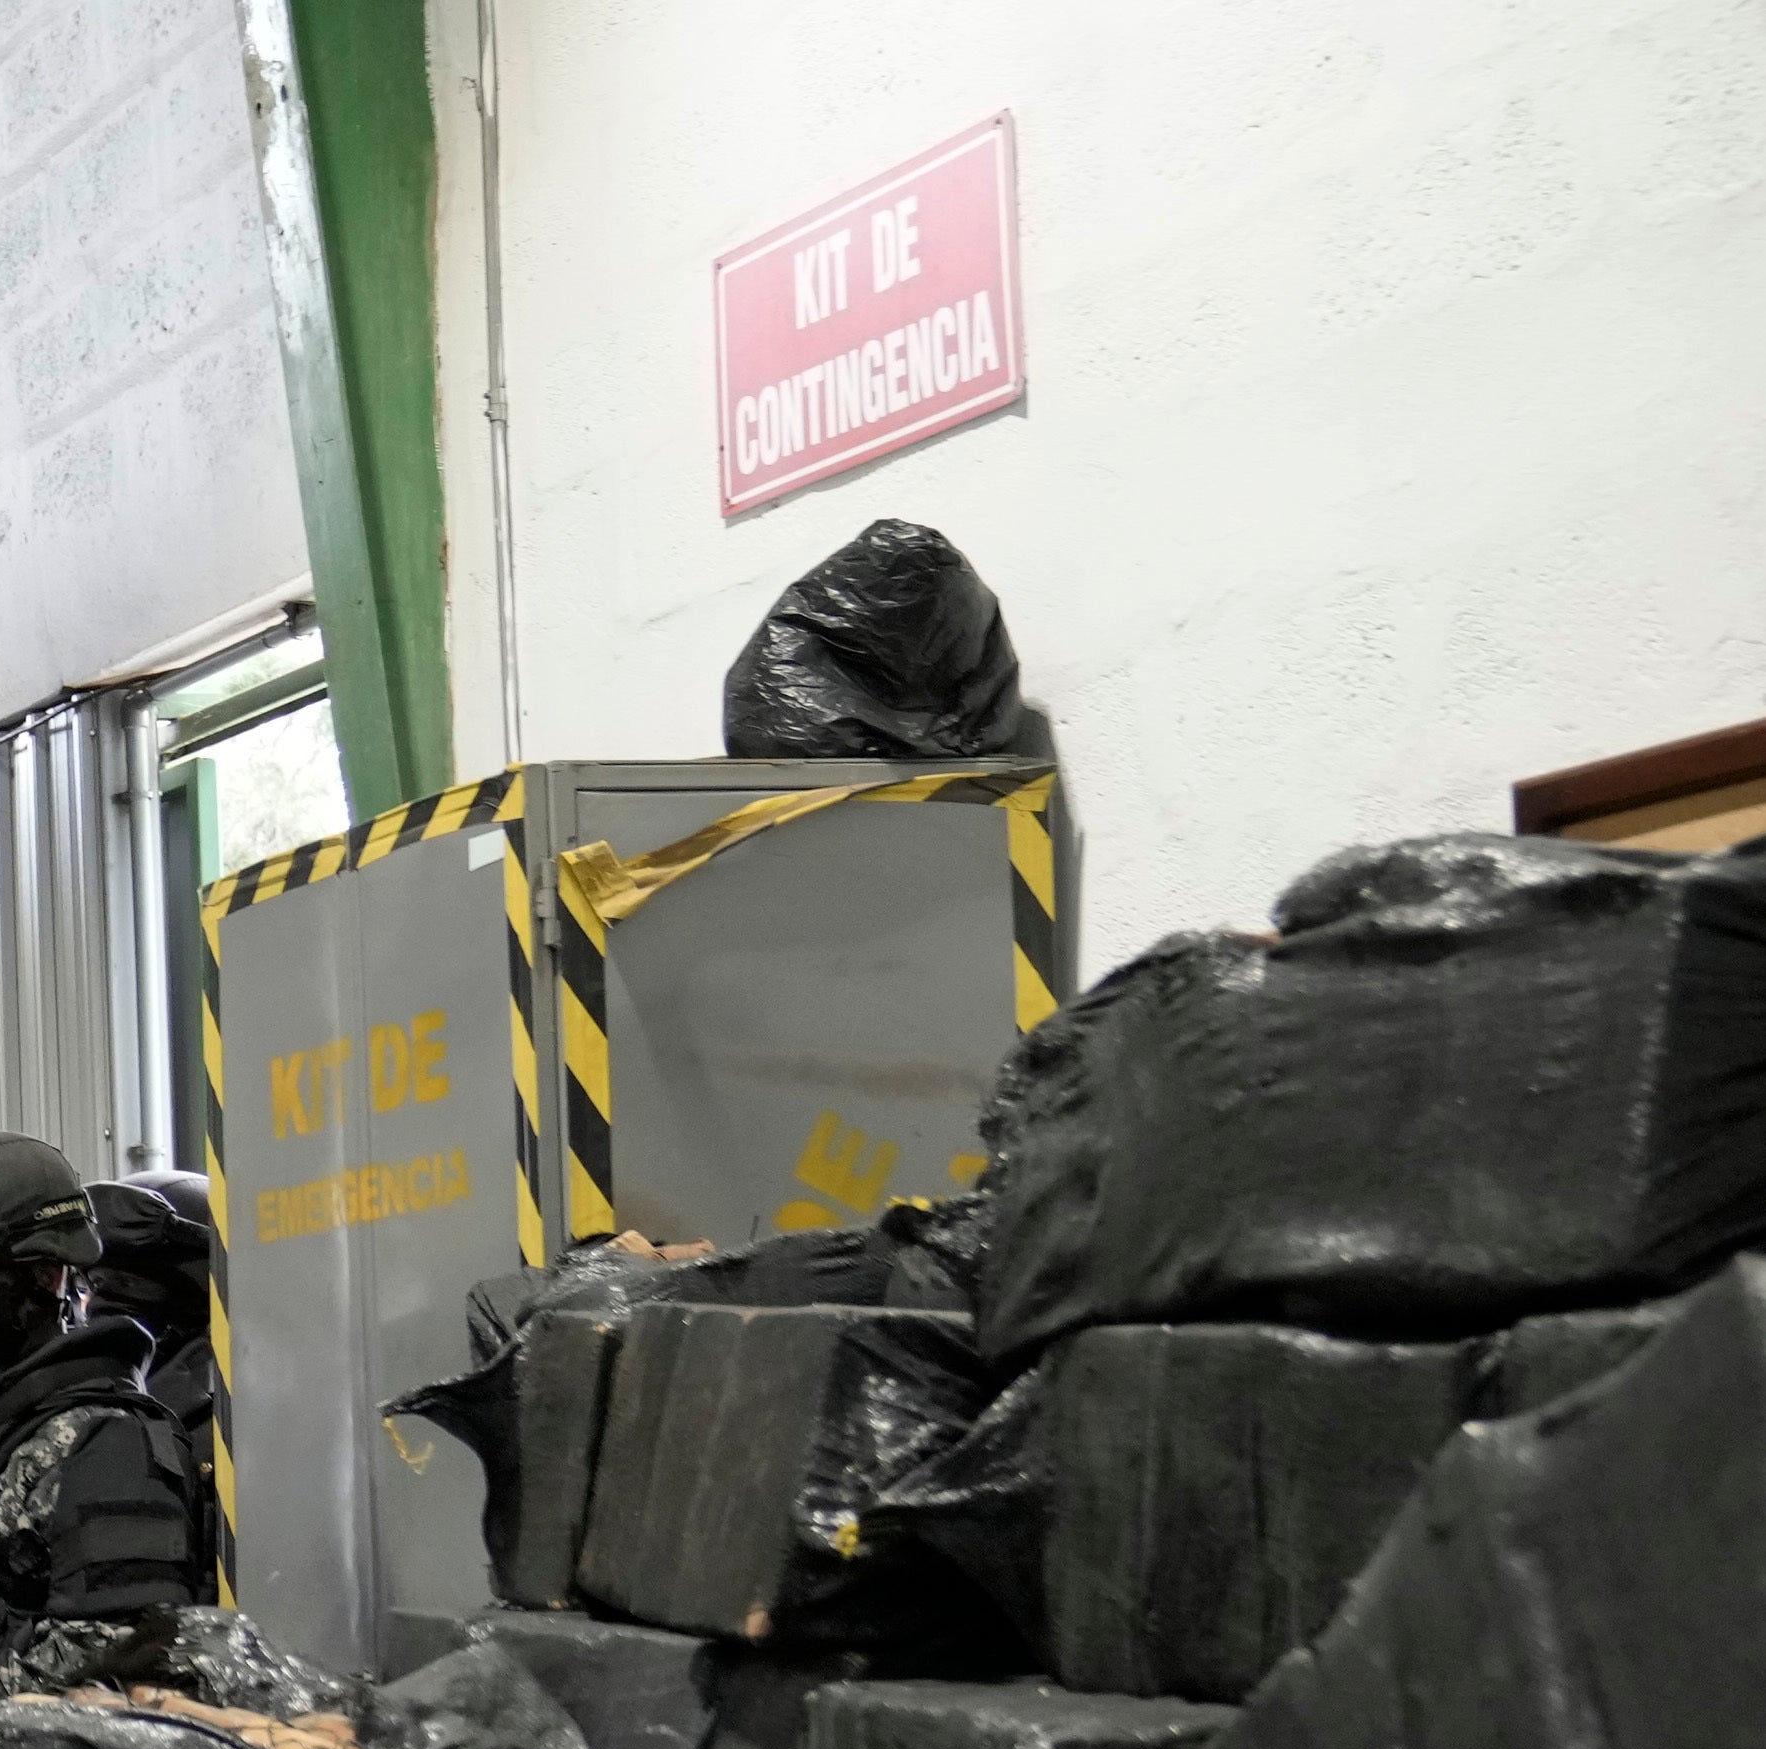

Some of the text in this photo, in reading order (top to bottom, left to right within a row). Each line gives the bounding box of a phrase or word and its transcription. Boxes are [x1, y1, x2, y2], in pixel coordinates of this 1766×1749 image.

[793, 195, 921, 331] KIT DE
[734, 290, 1000, 476] CONTINGENCIA
[270, 1007, 451, 1141] KIT DE
